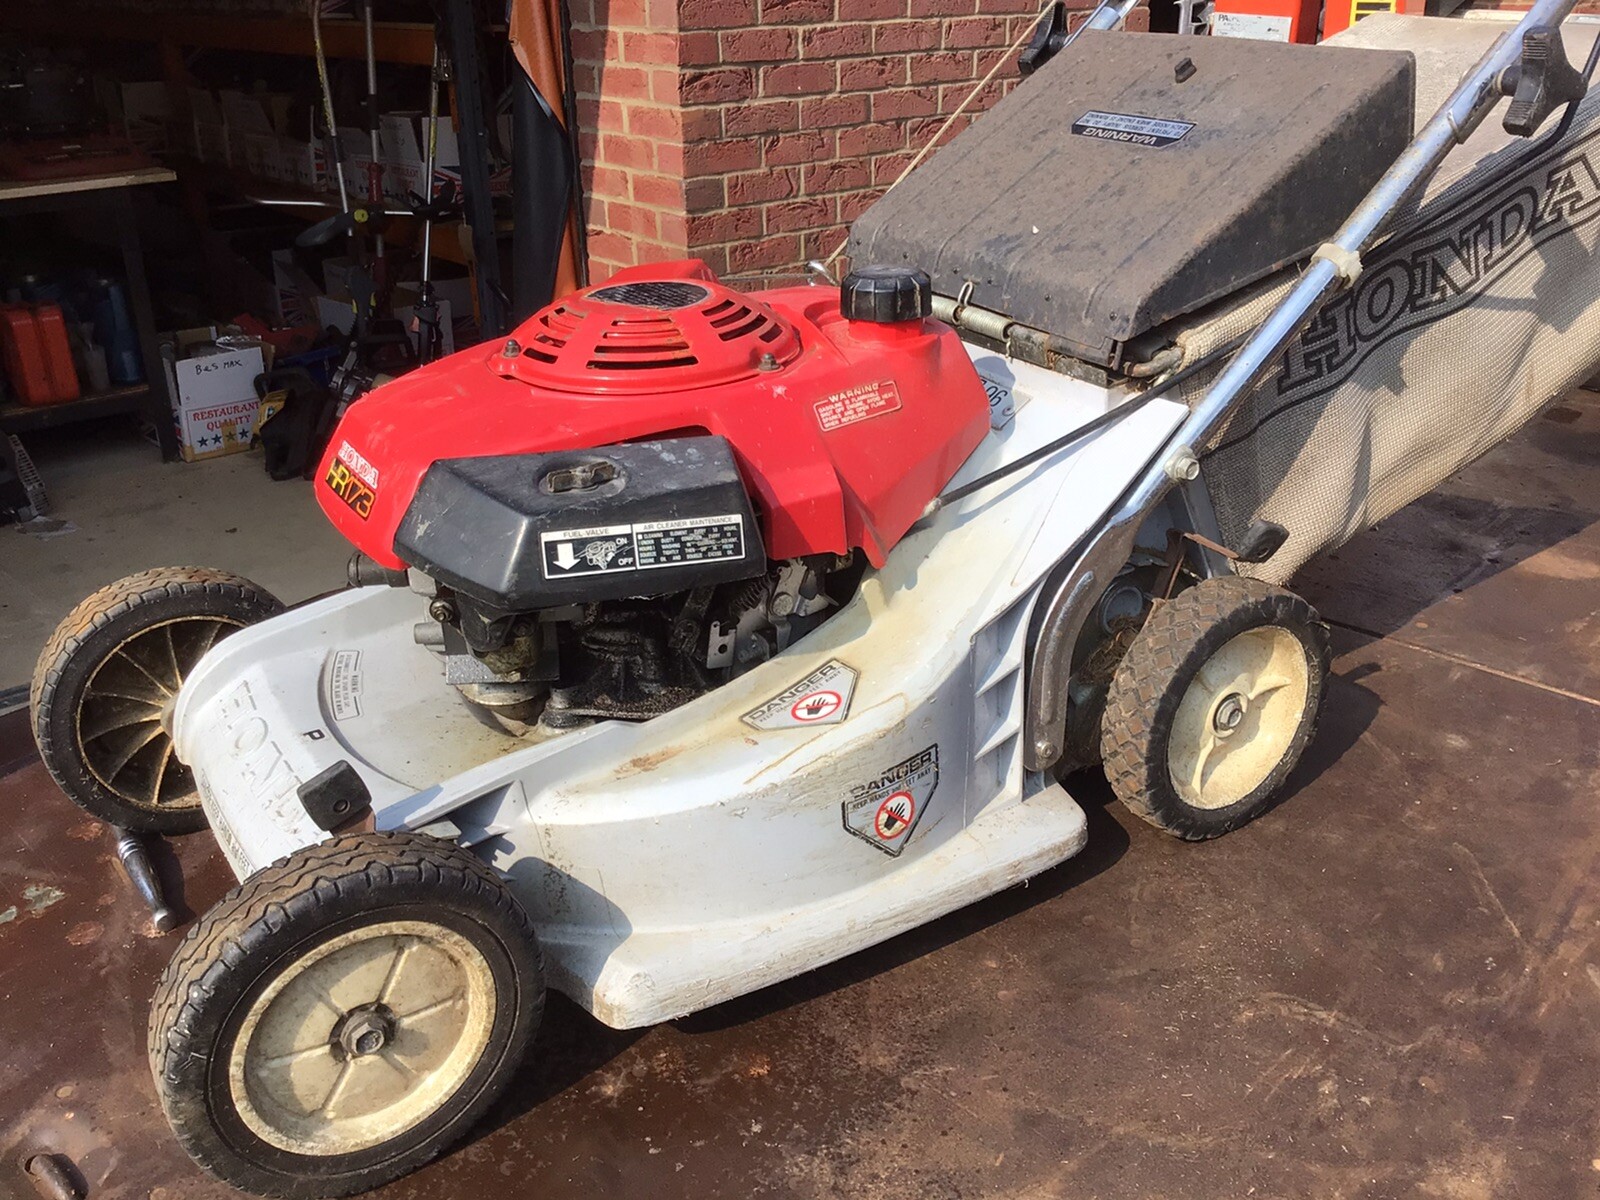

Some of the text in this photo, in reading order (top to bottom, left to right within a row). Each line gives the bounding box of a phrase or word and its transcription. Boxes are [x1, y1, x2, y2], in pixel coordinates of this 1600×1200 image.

[1082, 127, 1157, 145] WARNING
[1277, 153, 1600, 396] HONDA
[828, 383, 879, 403] WARNING
[193, 401, 260, 422] RESTAURANT
[207, 414, 251, 431] QUALITY
[338, 440, 379, 489] HONDA
[326, 457, 375, 518] HR173
[656, 521, 687, 529] CLEANER
[689, 516, 732, 525] MAINTENANCE
[563, 528, 609, 538] FUEL VALVE
[616, 537, 628, 545] ON
[618, 557, 634, 565] OFF
[749, 664, 837, 720] DANGER
[302, 728, 326, 741] P
[850, 752, 932, 799] DANGER
